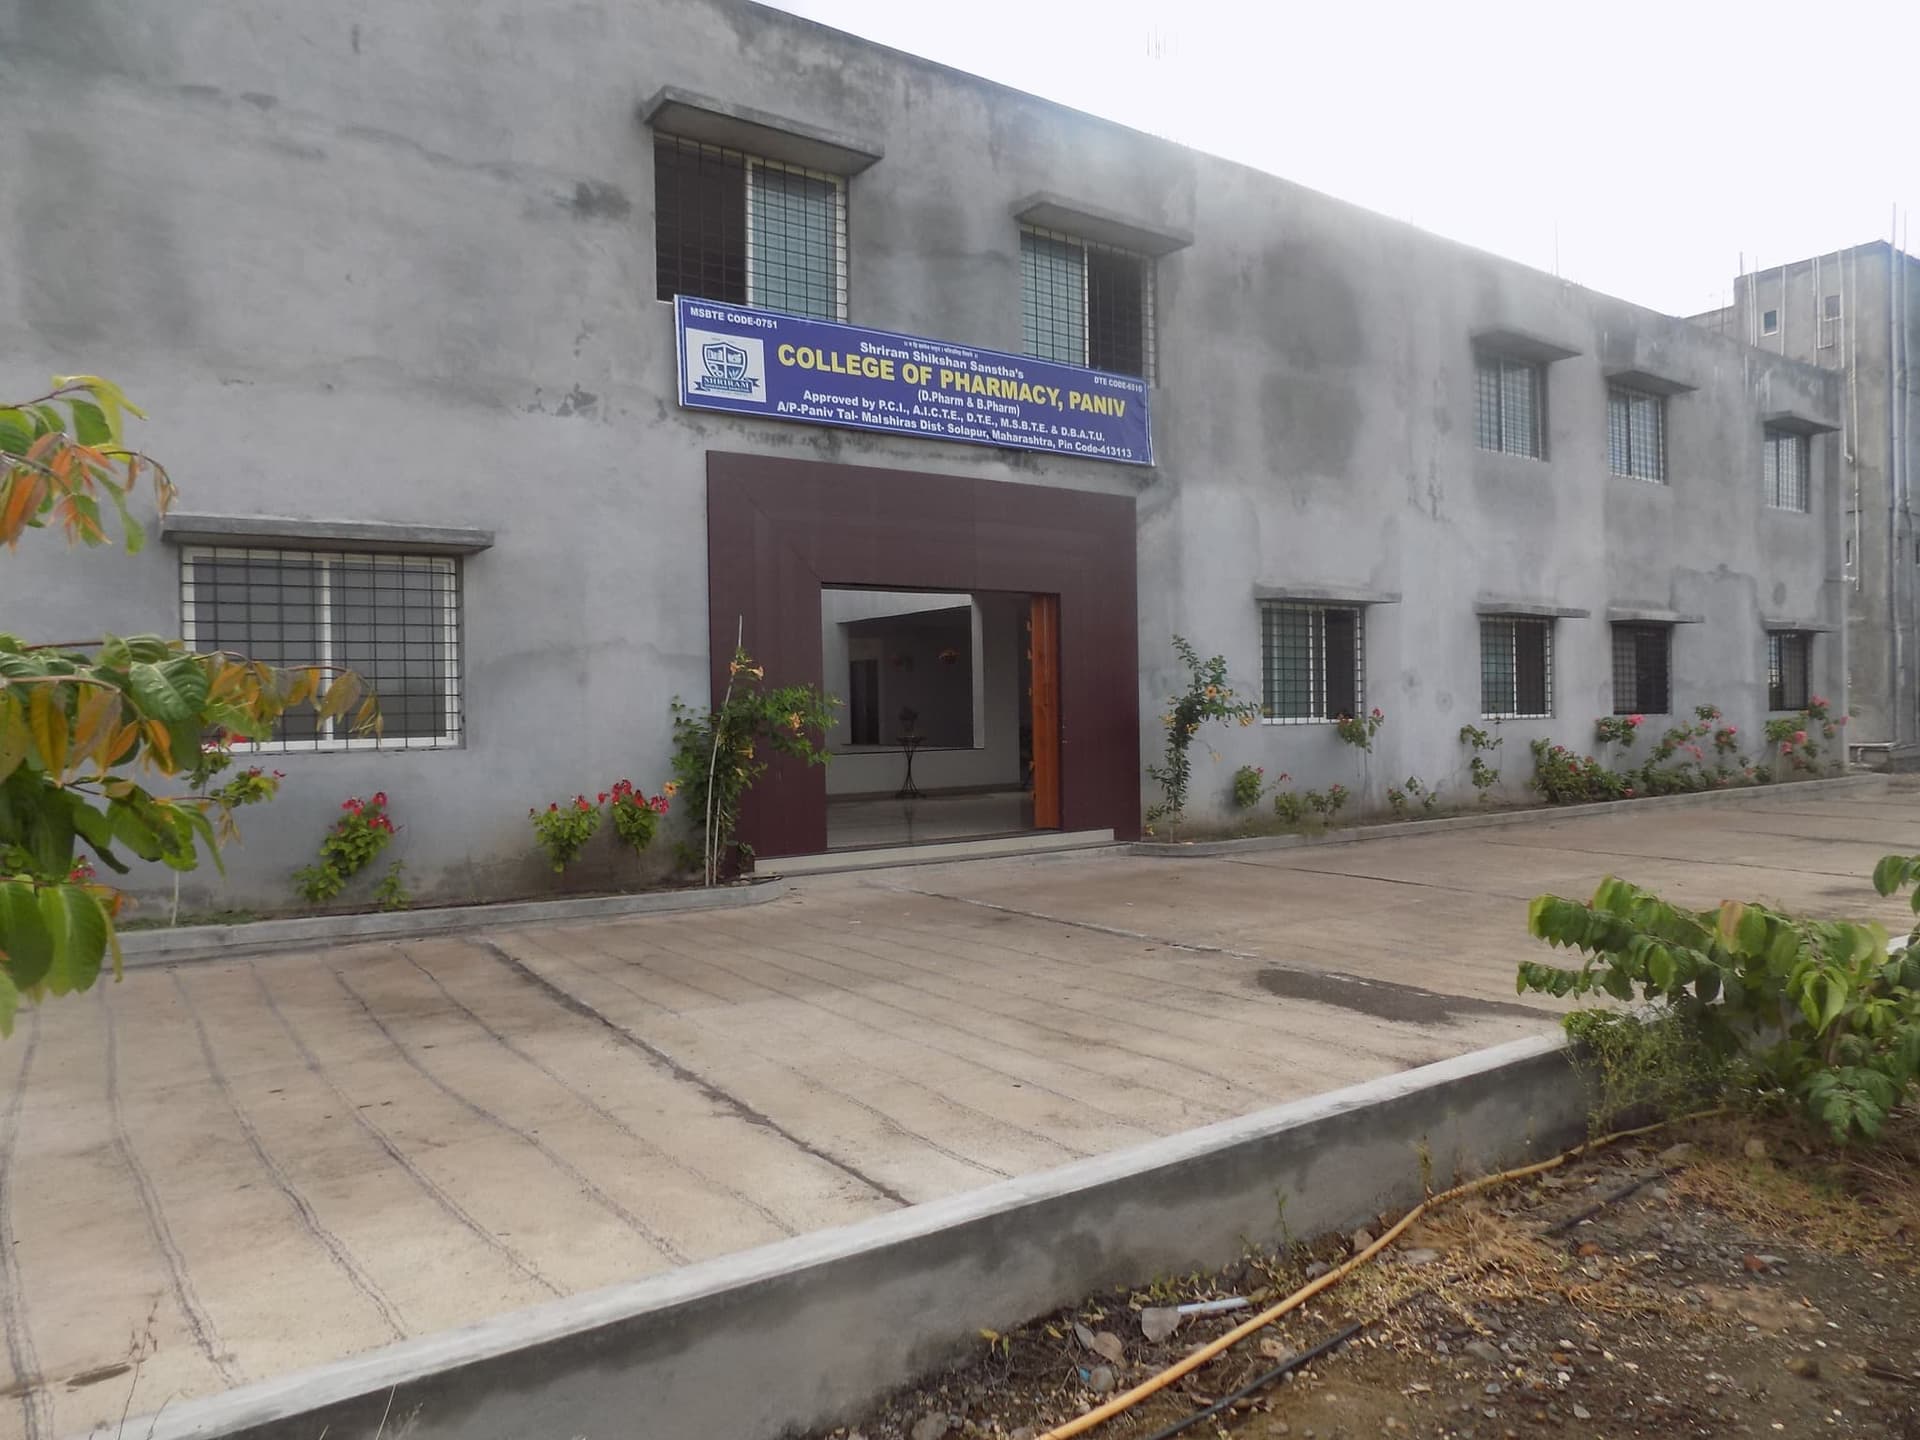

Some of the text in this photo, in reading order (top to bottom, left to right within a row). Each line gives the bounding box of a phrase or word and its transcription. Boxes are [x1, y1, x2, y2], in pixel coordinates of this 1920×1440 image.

[690, 307, 778, 329] MSBTE CODE-0751
[860, 341, 909, 360] Shriram
[913, 351, 967, 369] Shikshan
[970, 361, 1024, 379] Sanstha's
[778, 344, 895, 381] COLLEGE
[902, 363, 932, 386] OF
[940, 369, 1063, 411] PHARMACY,
[1069, 391, 1125, 417] PANIV
[1094, 376, 1107, 385] DTE
[803, 390, 859, 406] Approved
[862, 398, 875, 411] by
[1000, 418, 1048, 433] M.S.B.T.E.
[1051, 425, 1058, 435] &
[1061, 426, 1105, 442] D.B.A.T.U.
[918, 389, 1020, 418] (D.Pharm & B.Pharm)
[837, 408, 858, 420] Tal-
[920, 419, 944, 432] Dist-
[947, 423, 990, 439] Solapur,
[992, 429, 1056, 448] Maharashtra,
[1058, 439, 1073, 449] Pin
[1075, 442, 1132, 458] Code-413113
